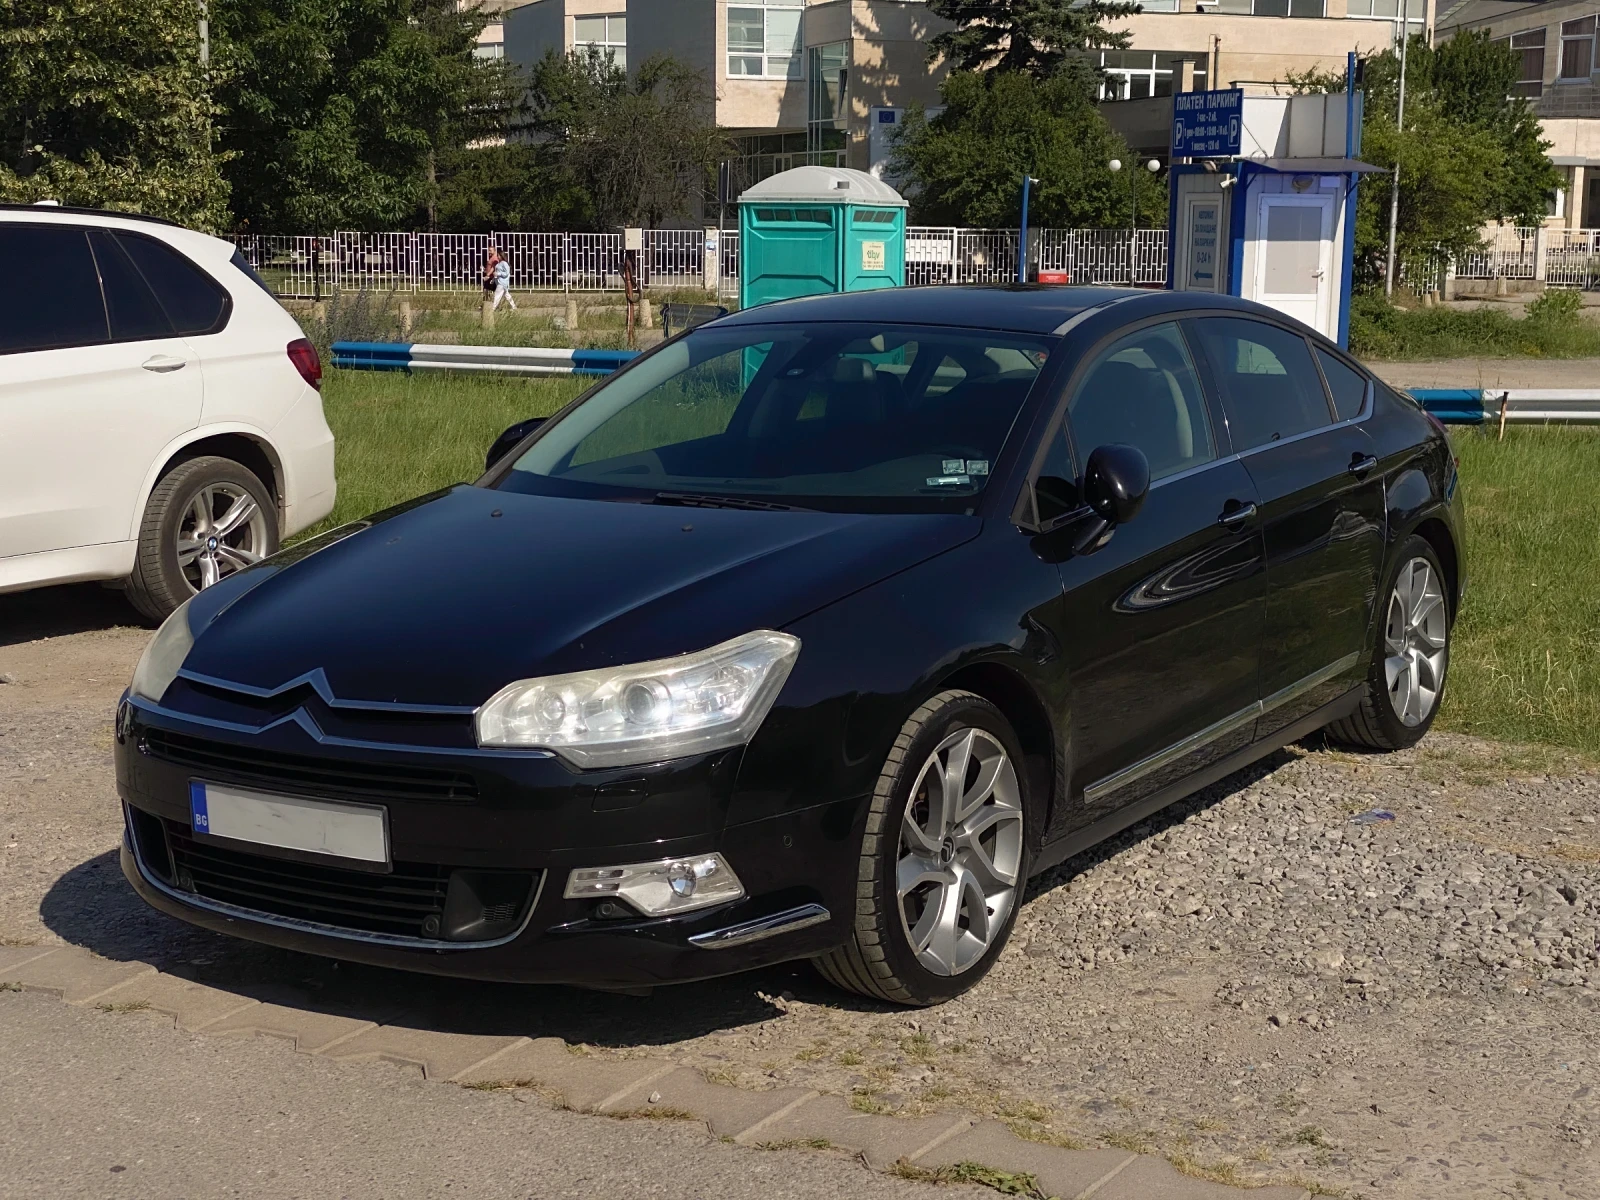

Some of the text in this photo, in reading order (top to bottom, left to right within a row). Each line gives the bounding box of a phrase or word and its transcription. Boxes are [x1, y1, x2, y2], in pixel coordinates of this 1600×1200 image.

[1176, 92, 1240, 110] ПЛАТЕН ПАРКИНГ
[1197, 252, 1207, 263] 0-24
[196, 814, 207, 826] BG
